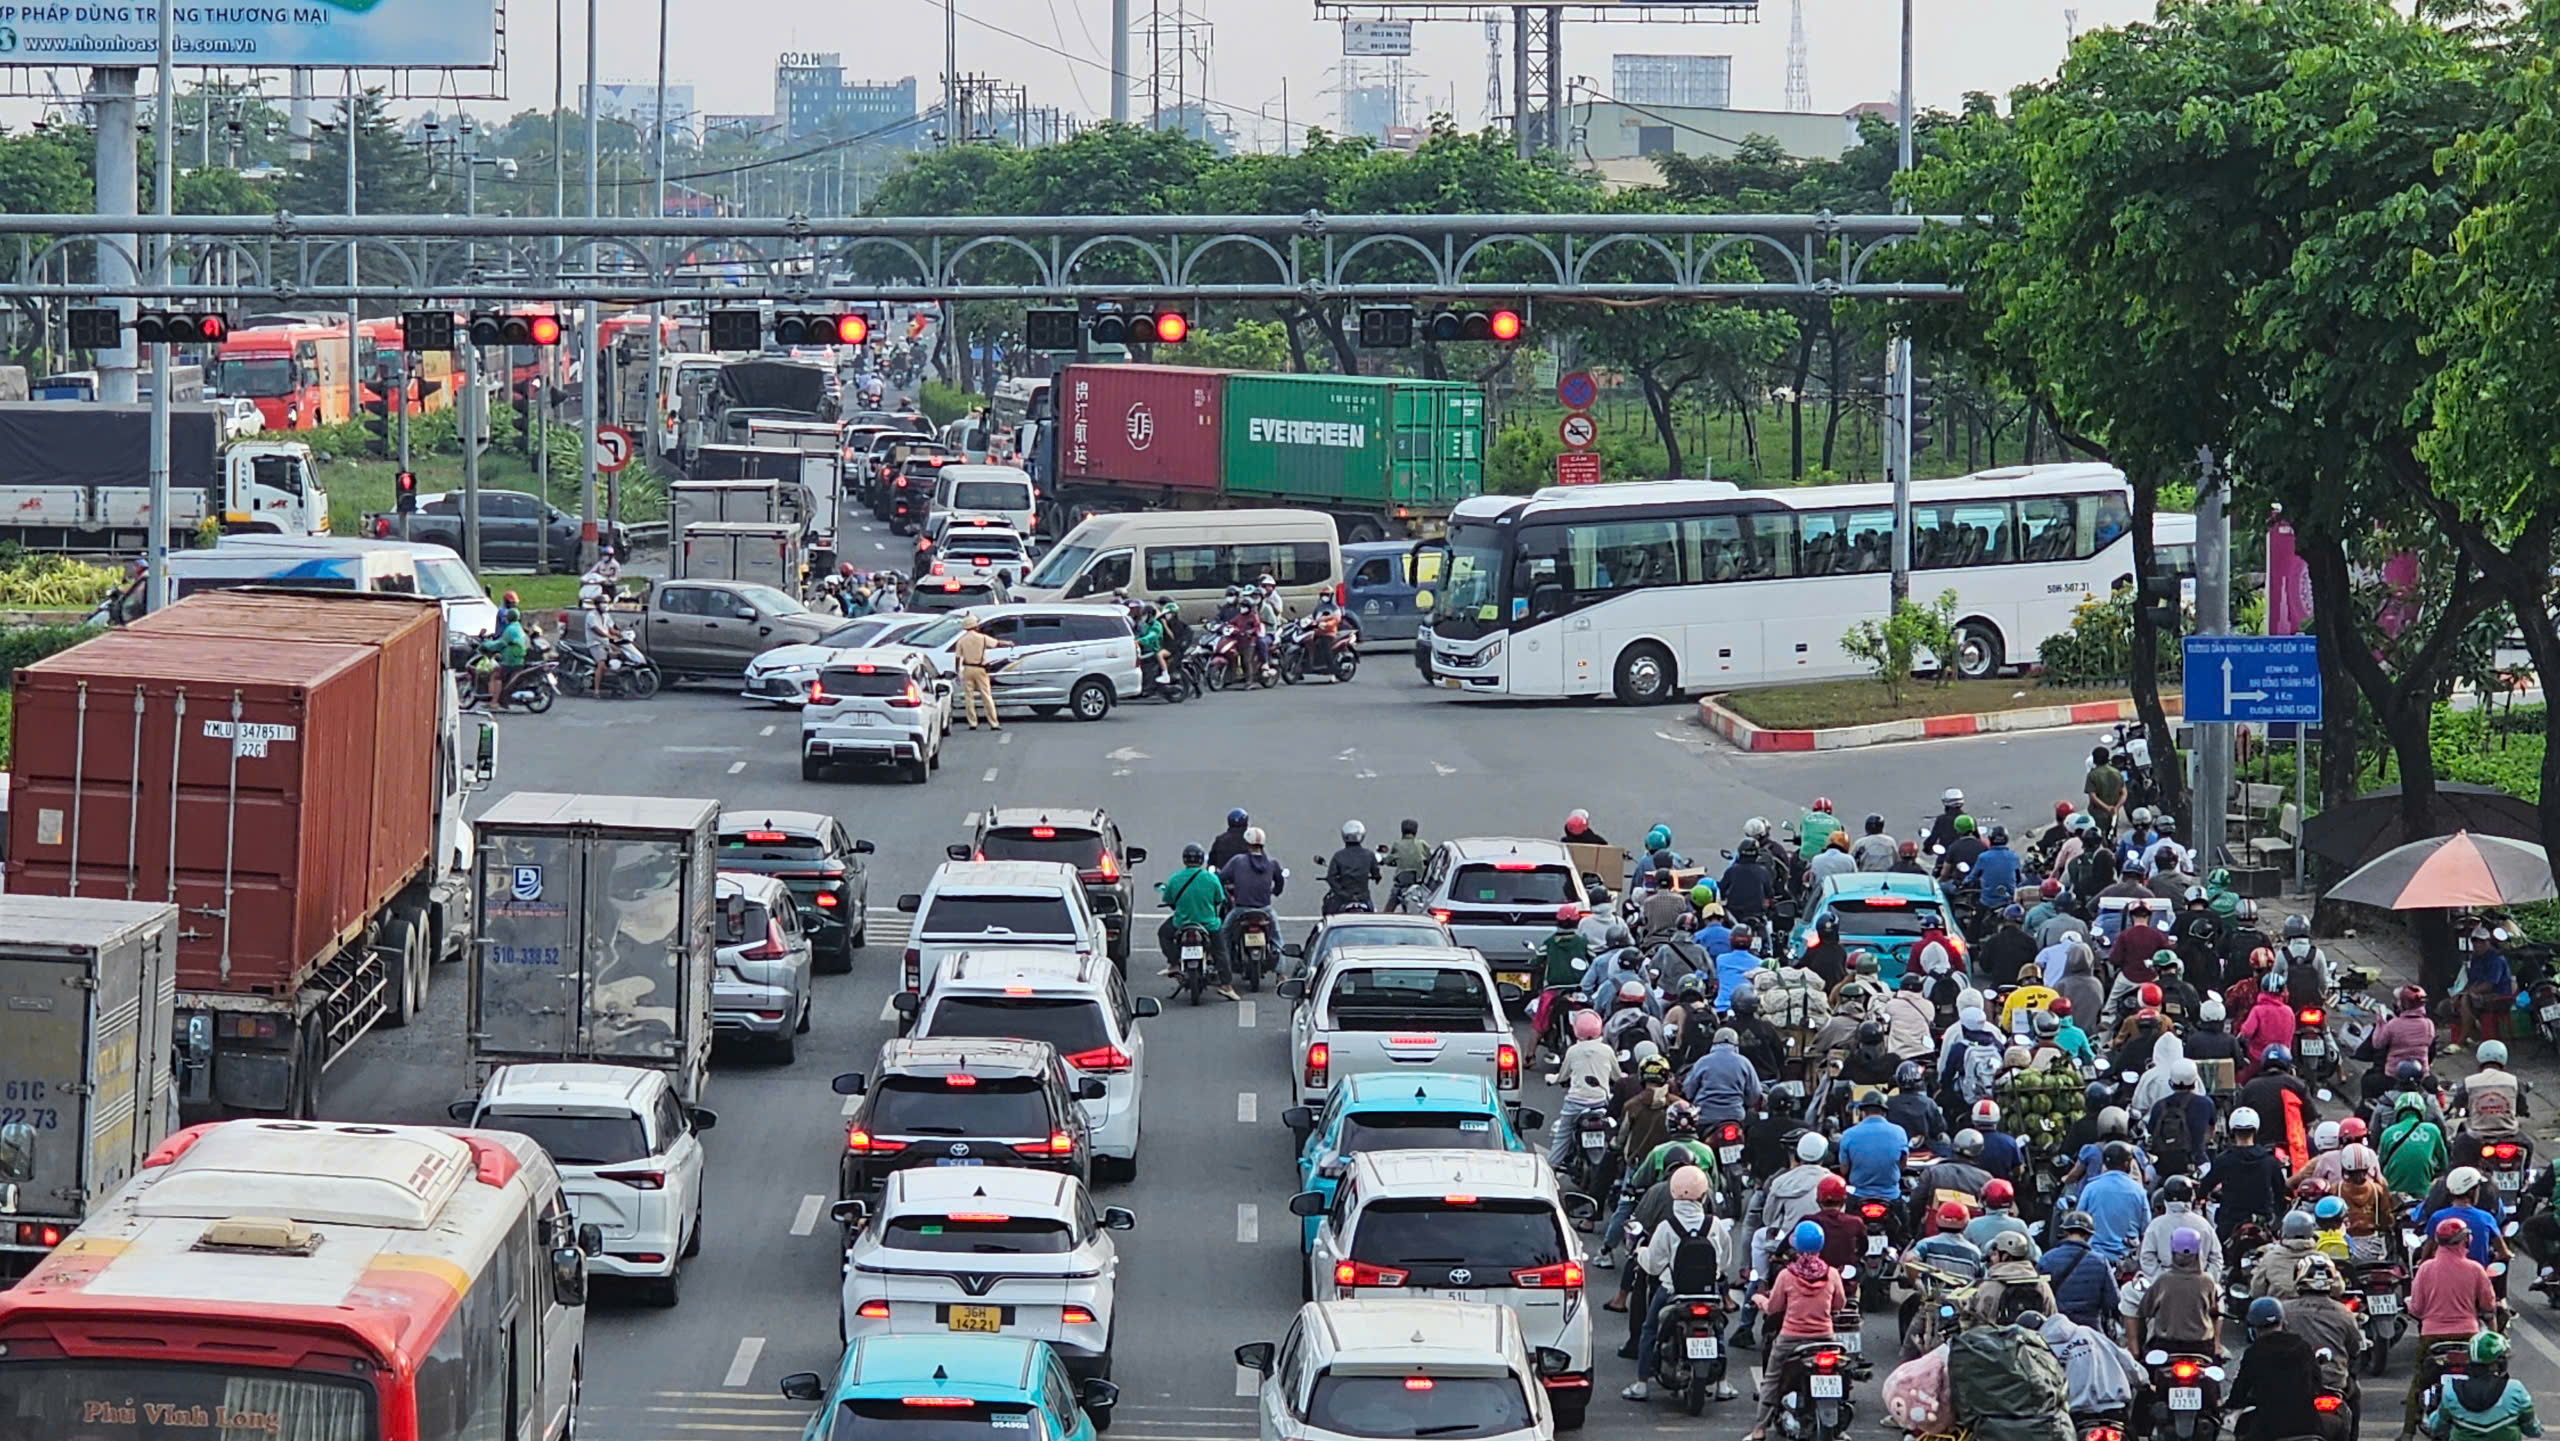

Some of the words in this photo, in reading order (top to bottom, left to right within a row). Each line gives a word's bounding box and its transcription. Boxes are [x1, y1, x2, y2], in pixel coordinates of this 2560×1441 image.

[22, 3, 69, 21] PHÁP
[76, 4, 129, 21] DÙNG
[135, 7, 198, 22] TRNG
[205, 7, 286, 23] THƯƠNG
[294, 8, 328, 26] MẠI
[24, 34, 256, 53] www.nhonhoasle.com.vn
[1249, 417, 1365, 449] EVERGREEN
[205, 722, 232, 737] YMLU
[242, 725, 280, 739] 347851
[242, 743, 267, 757] 22G1
[7, 1080, 45, 1100] 61C
[2393, 1127, 2430, 1141] Gab
[84, 1398, 136, 1424] Phú
[216, 1405, 280, 1432] Long
